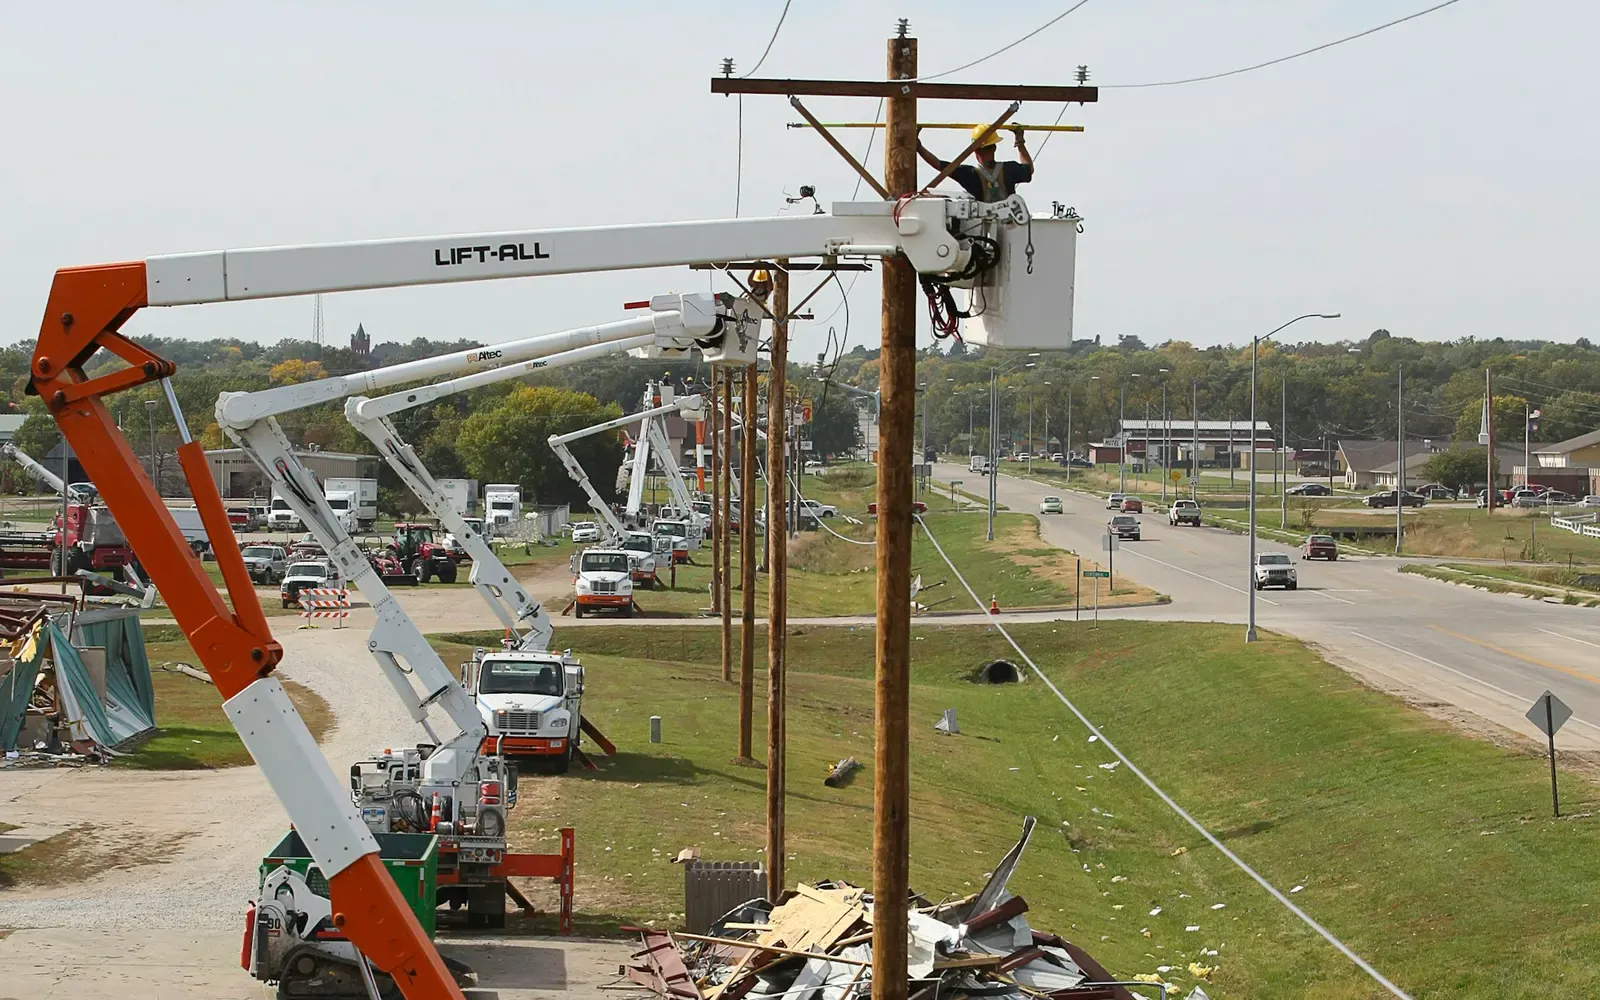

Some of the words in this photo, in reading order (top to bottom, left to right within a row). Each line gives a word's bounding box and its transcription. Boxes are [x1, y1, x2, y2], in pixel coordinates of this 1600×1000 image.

[434, 242, 550, 266] LIFT-ALL
[478, 350, 502, 361] Altec
[1105, 439, 1119, 447] MOTEL
